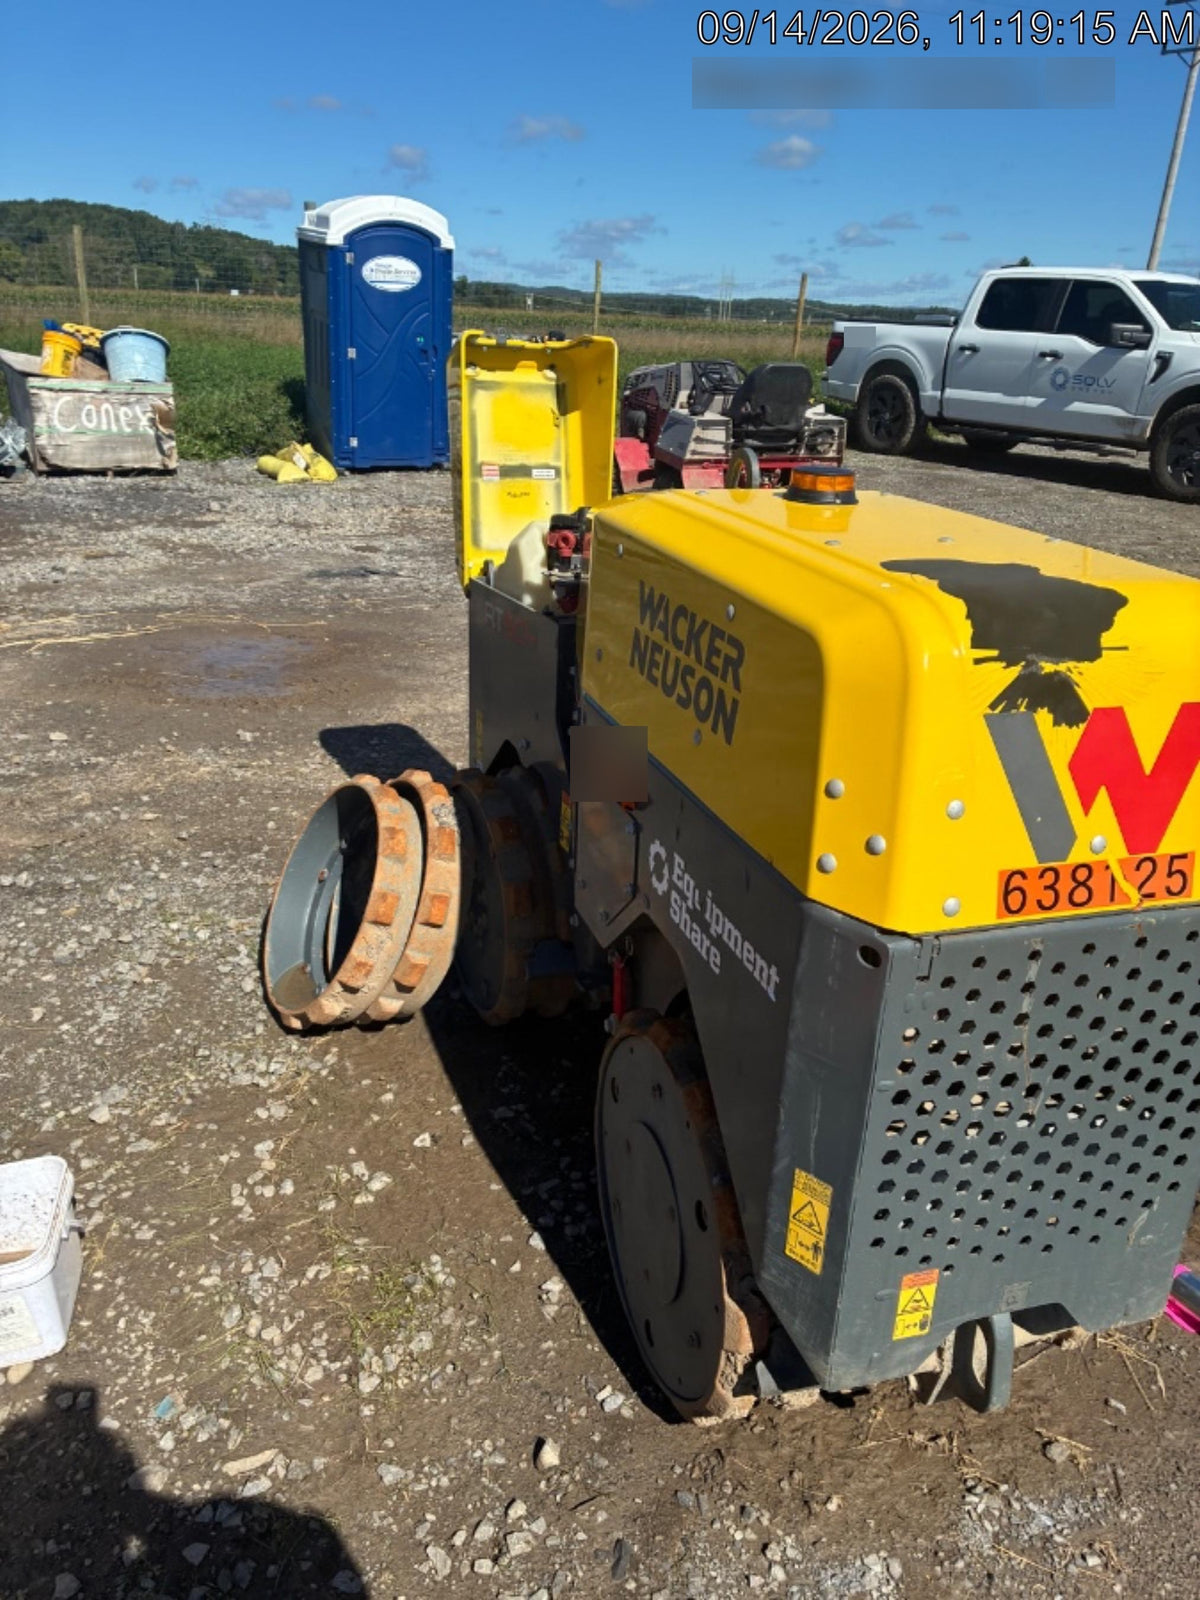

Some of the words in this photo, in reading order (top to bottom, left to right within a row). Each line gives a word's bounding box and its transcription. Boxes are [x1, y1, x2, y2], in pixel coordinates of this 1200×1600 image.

[1072, 374, 1118, 388] SOLV
[639, 579, 745, 693] WACKER
[629, 627, 740, 746] NEUSON
[1003, 853, 1188, 915] 638125
[669, 890, 721, 975] Share
